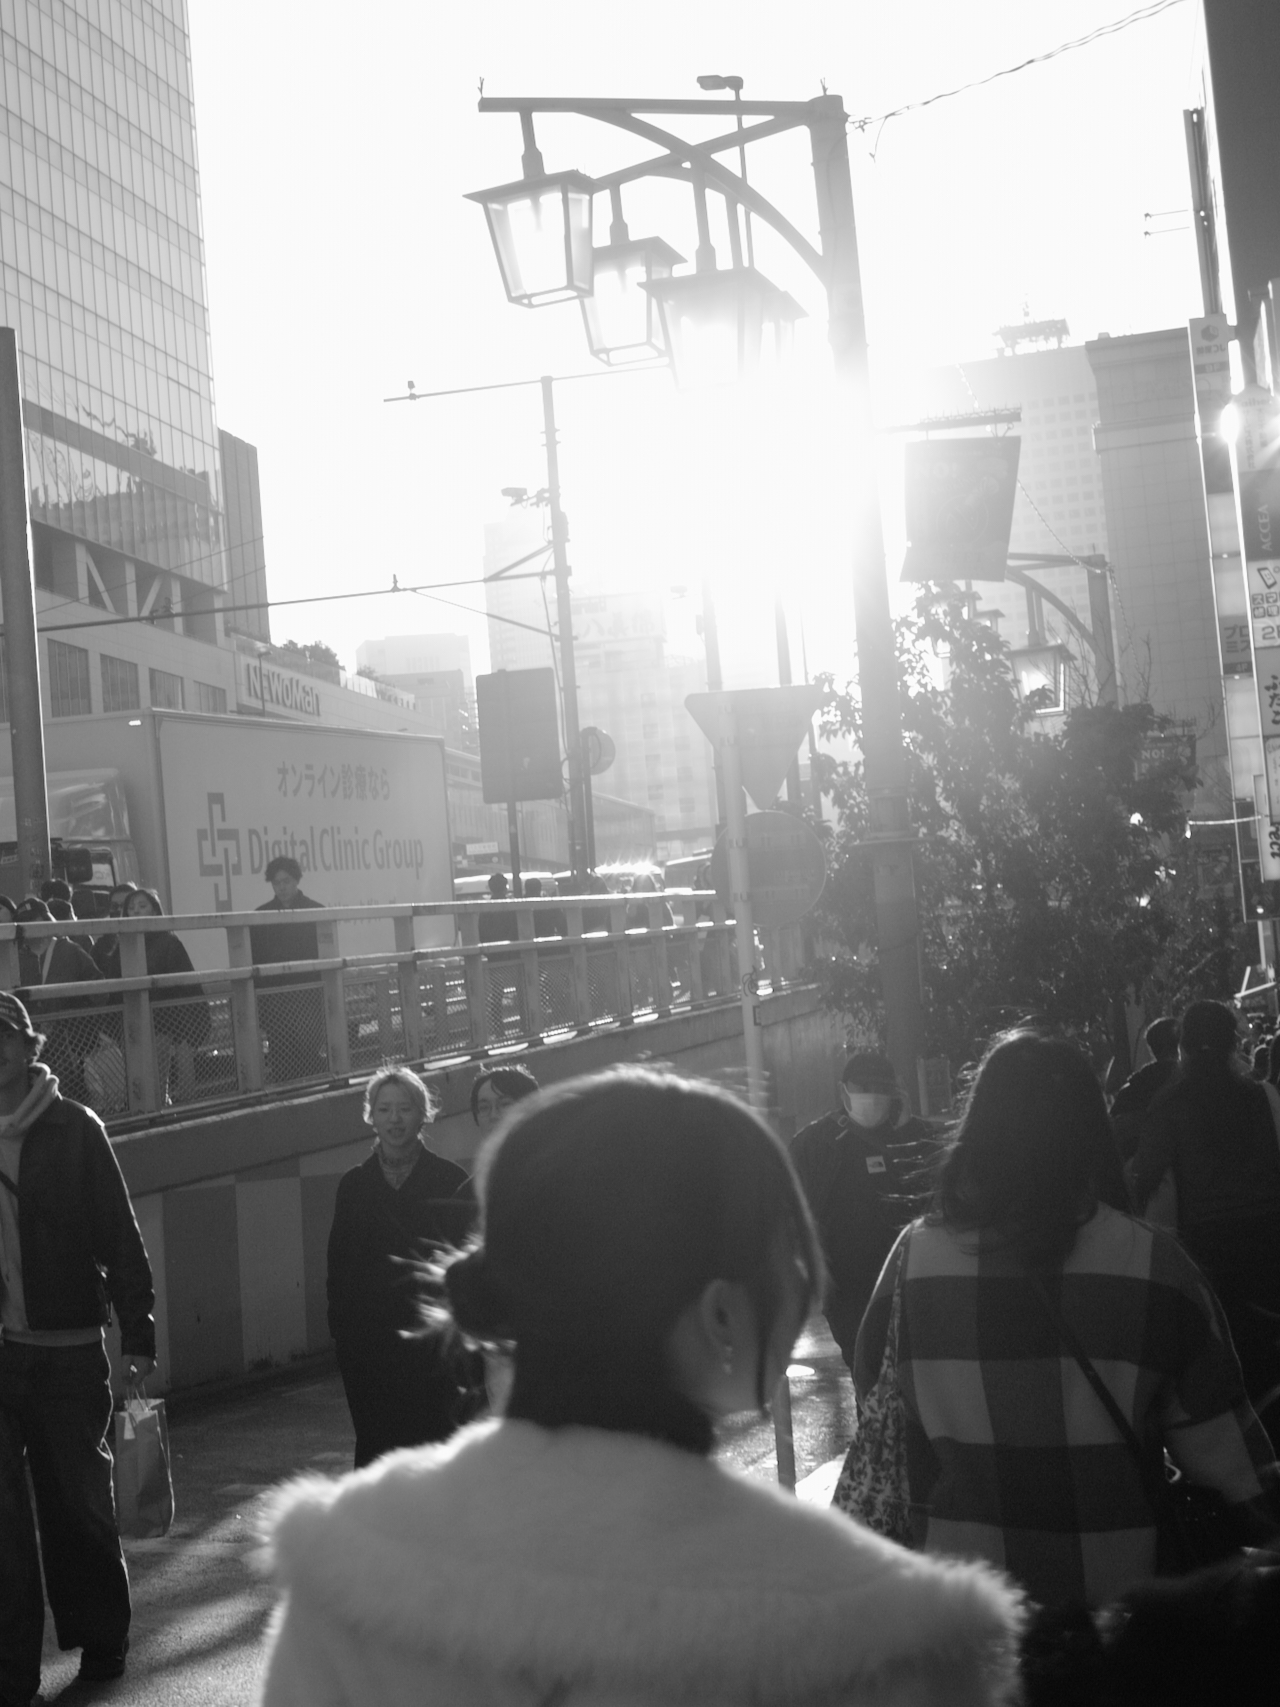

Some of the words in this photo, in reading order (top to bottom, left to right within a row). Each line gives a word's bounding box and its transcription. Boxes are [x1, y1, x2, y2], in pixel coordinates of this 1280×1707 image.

[1257, 504, 1273, 551] ACCEA
[276, 761, 391, 801] オンライン診療なら
[319, 825, 371, 872] Clinic
[373, 829, 424, 881] Group
